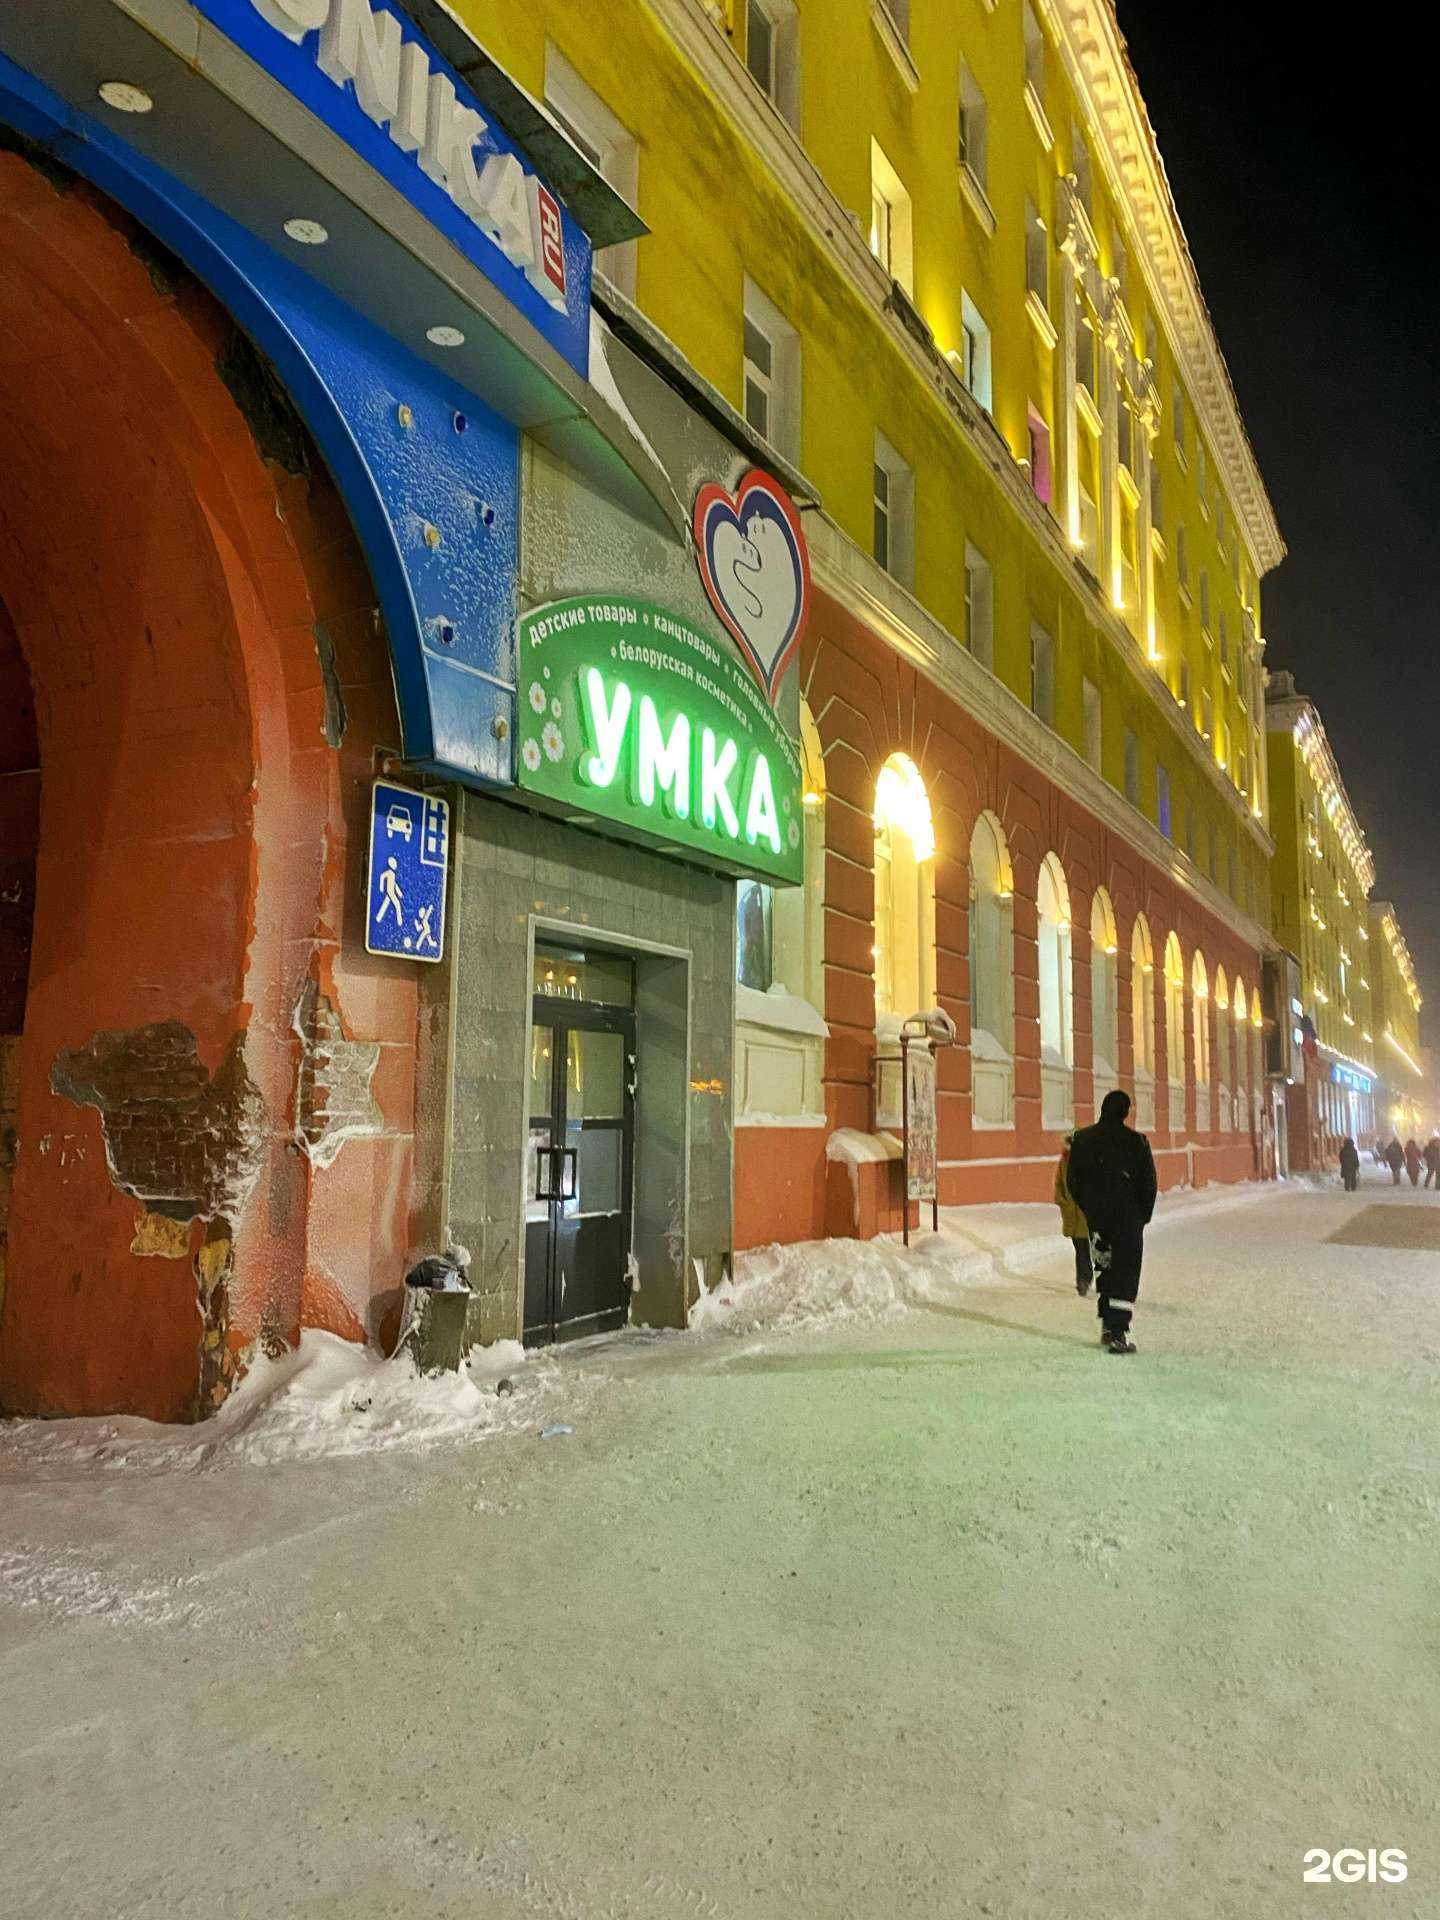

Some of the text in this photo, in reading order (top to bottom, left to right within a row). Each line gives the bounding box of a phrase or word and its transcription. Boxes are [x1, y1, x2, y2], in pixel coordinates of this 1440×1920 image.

[528, 605, 586, 647] детские
[587, 604, 637, 625] товары
[654, 613, 721, 666] канцтовары
[732, 669, 776, 732] головные
[618, 639, 748, 728] белорусская косметика
[583, 666, 781, 854] УМКА
